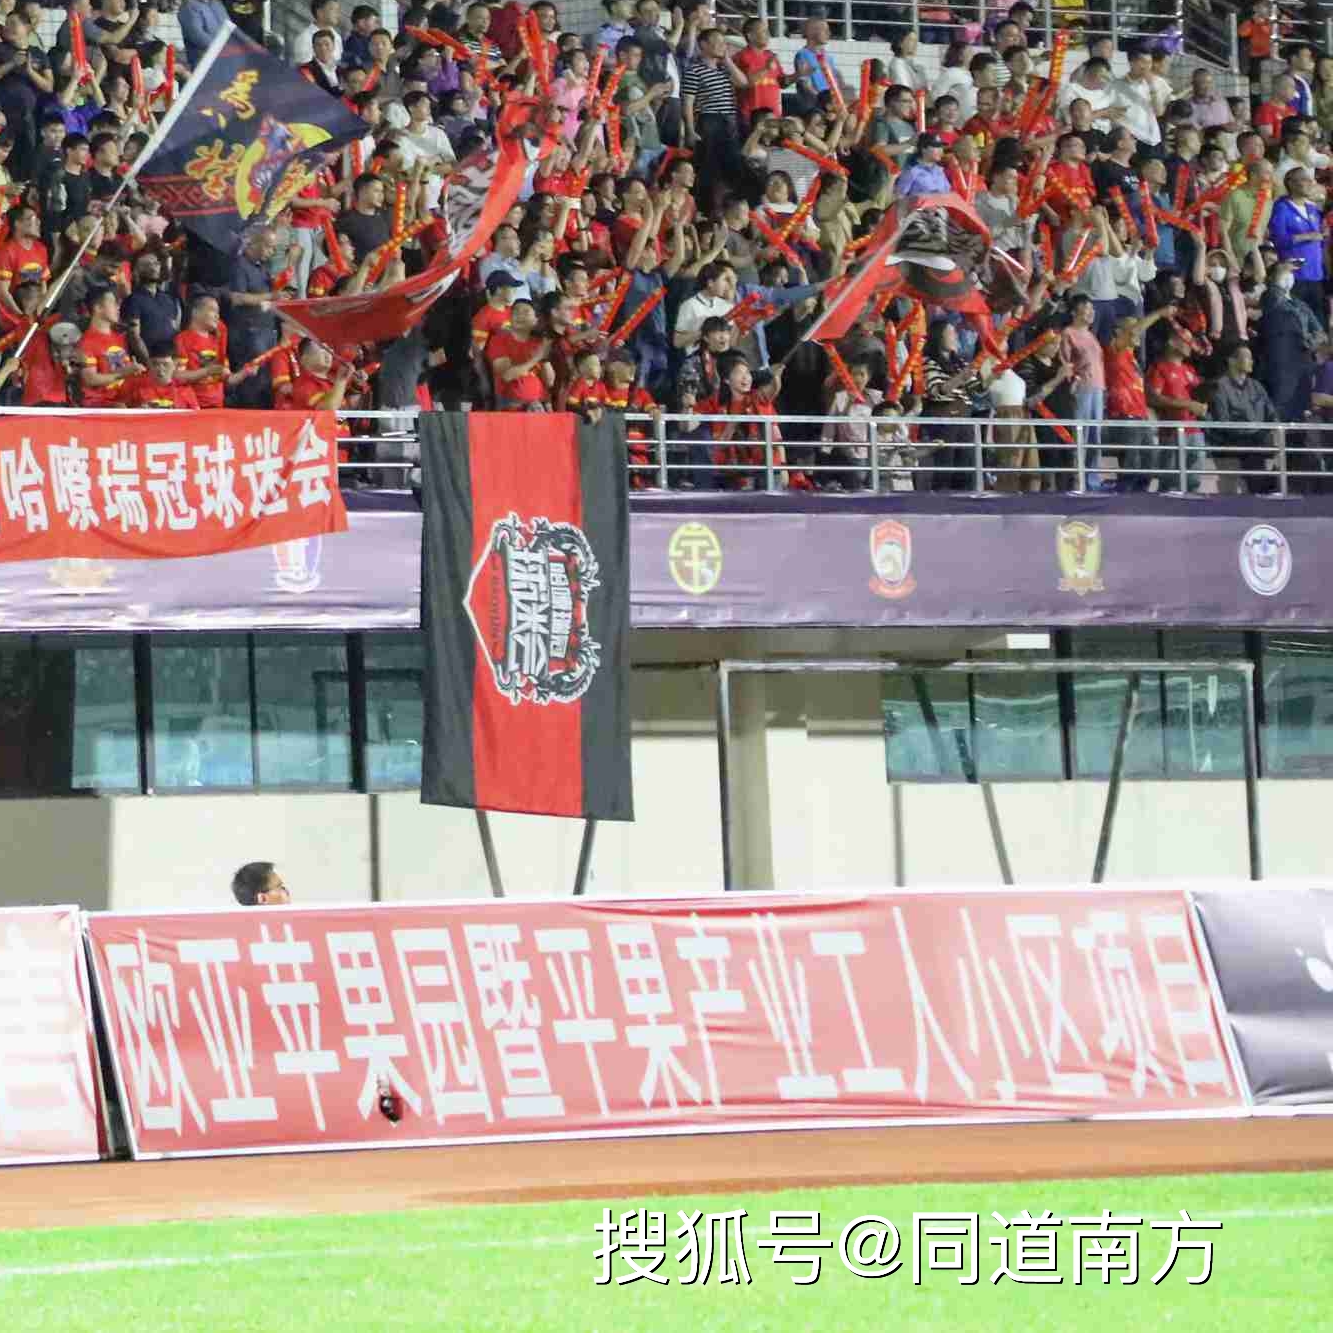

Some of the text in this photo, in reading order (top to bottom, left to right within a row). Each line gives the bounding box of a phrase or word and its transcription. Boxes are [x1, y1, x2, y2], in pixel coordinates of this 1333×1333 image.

[103, 906, 1235, 1140] 欧亚苹果园暨平果产业工人小区项目
